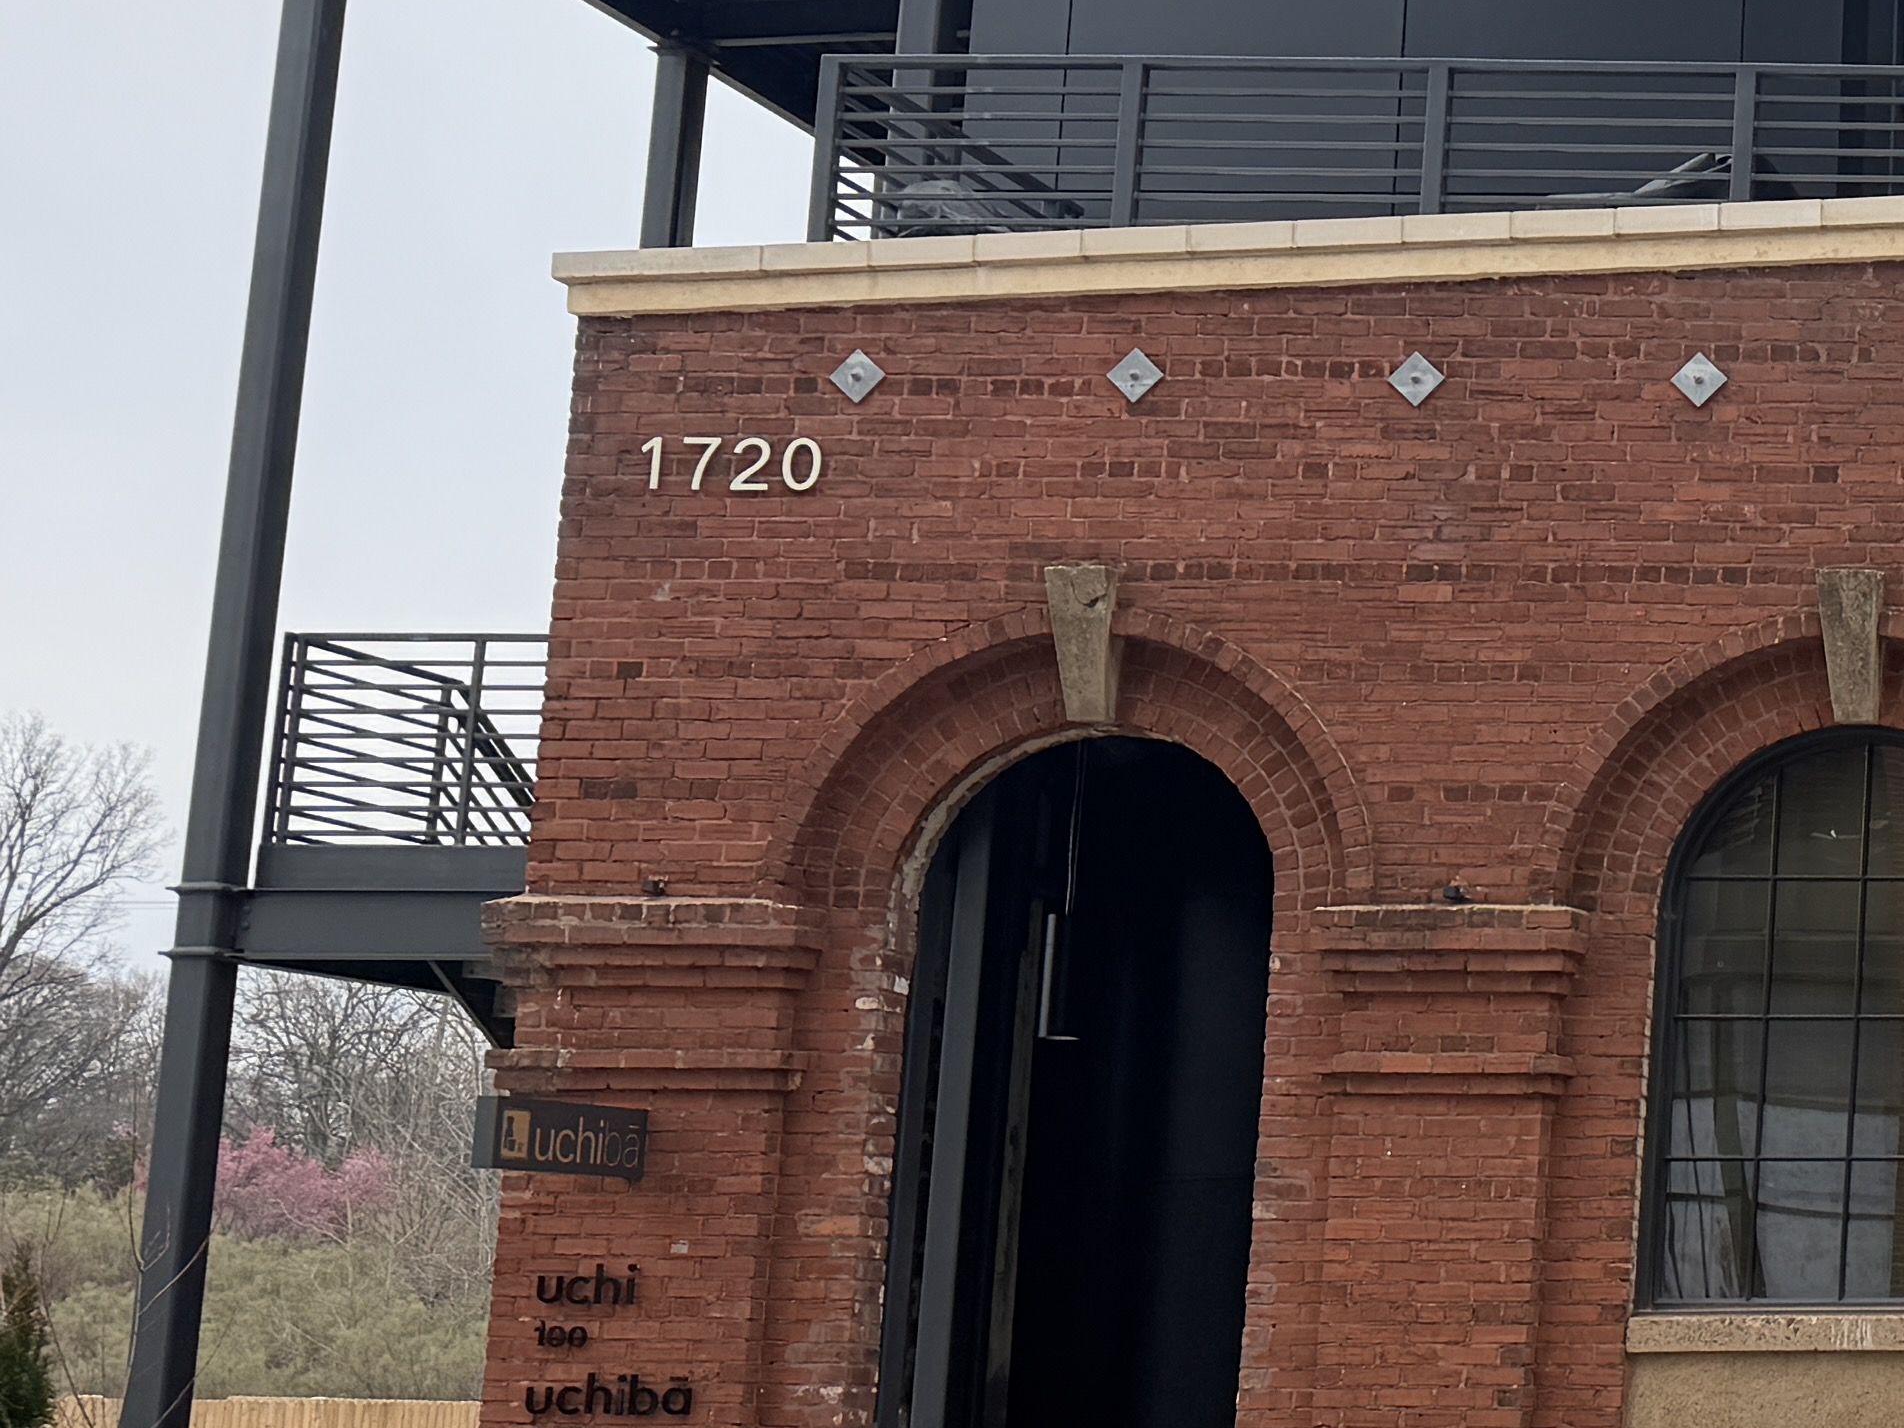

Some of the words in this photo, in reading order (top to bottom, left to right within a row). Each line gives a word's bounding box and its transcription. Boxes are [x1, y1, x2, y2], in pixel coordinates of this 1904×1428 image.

[641, 436, 822, 491] 1720
[533, 1115, 642, 1169] uchibā
[536, 1263, 640, 1306] uchi
[534, 1319, 588, 1348] 100
[524, 1372, 693, 1417] uchibā
